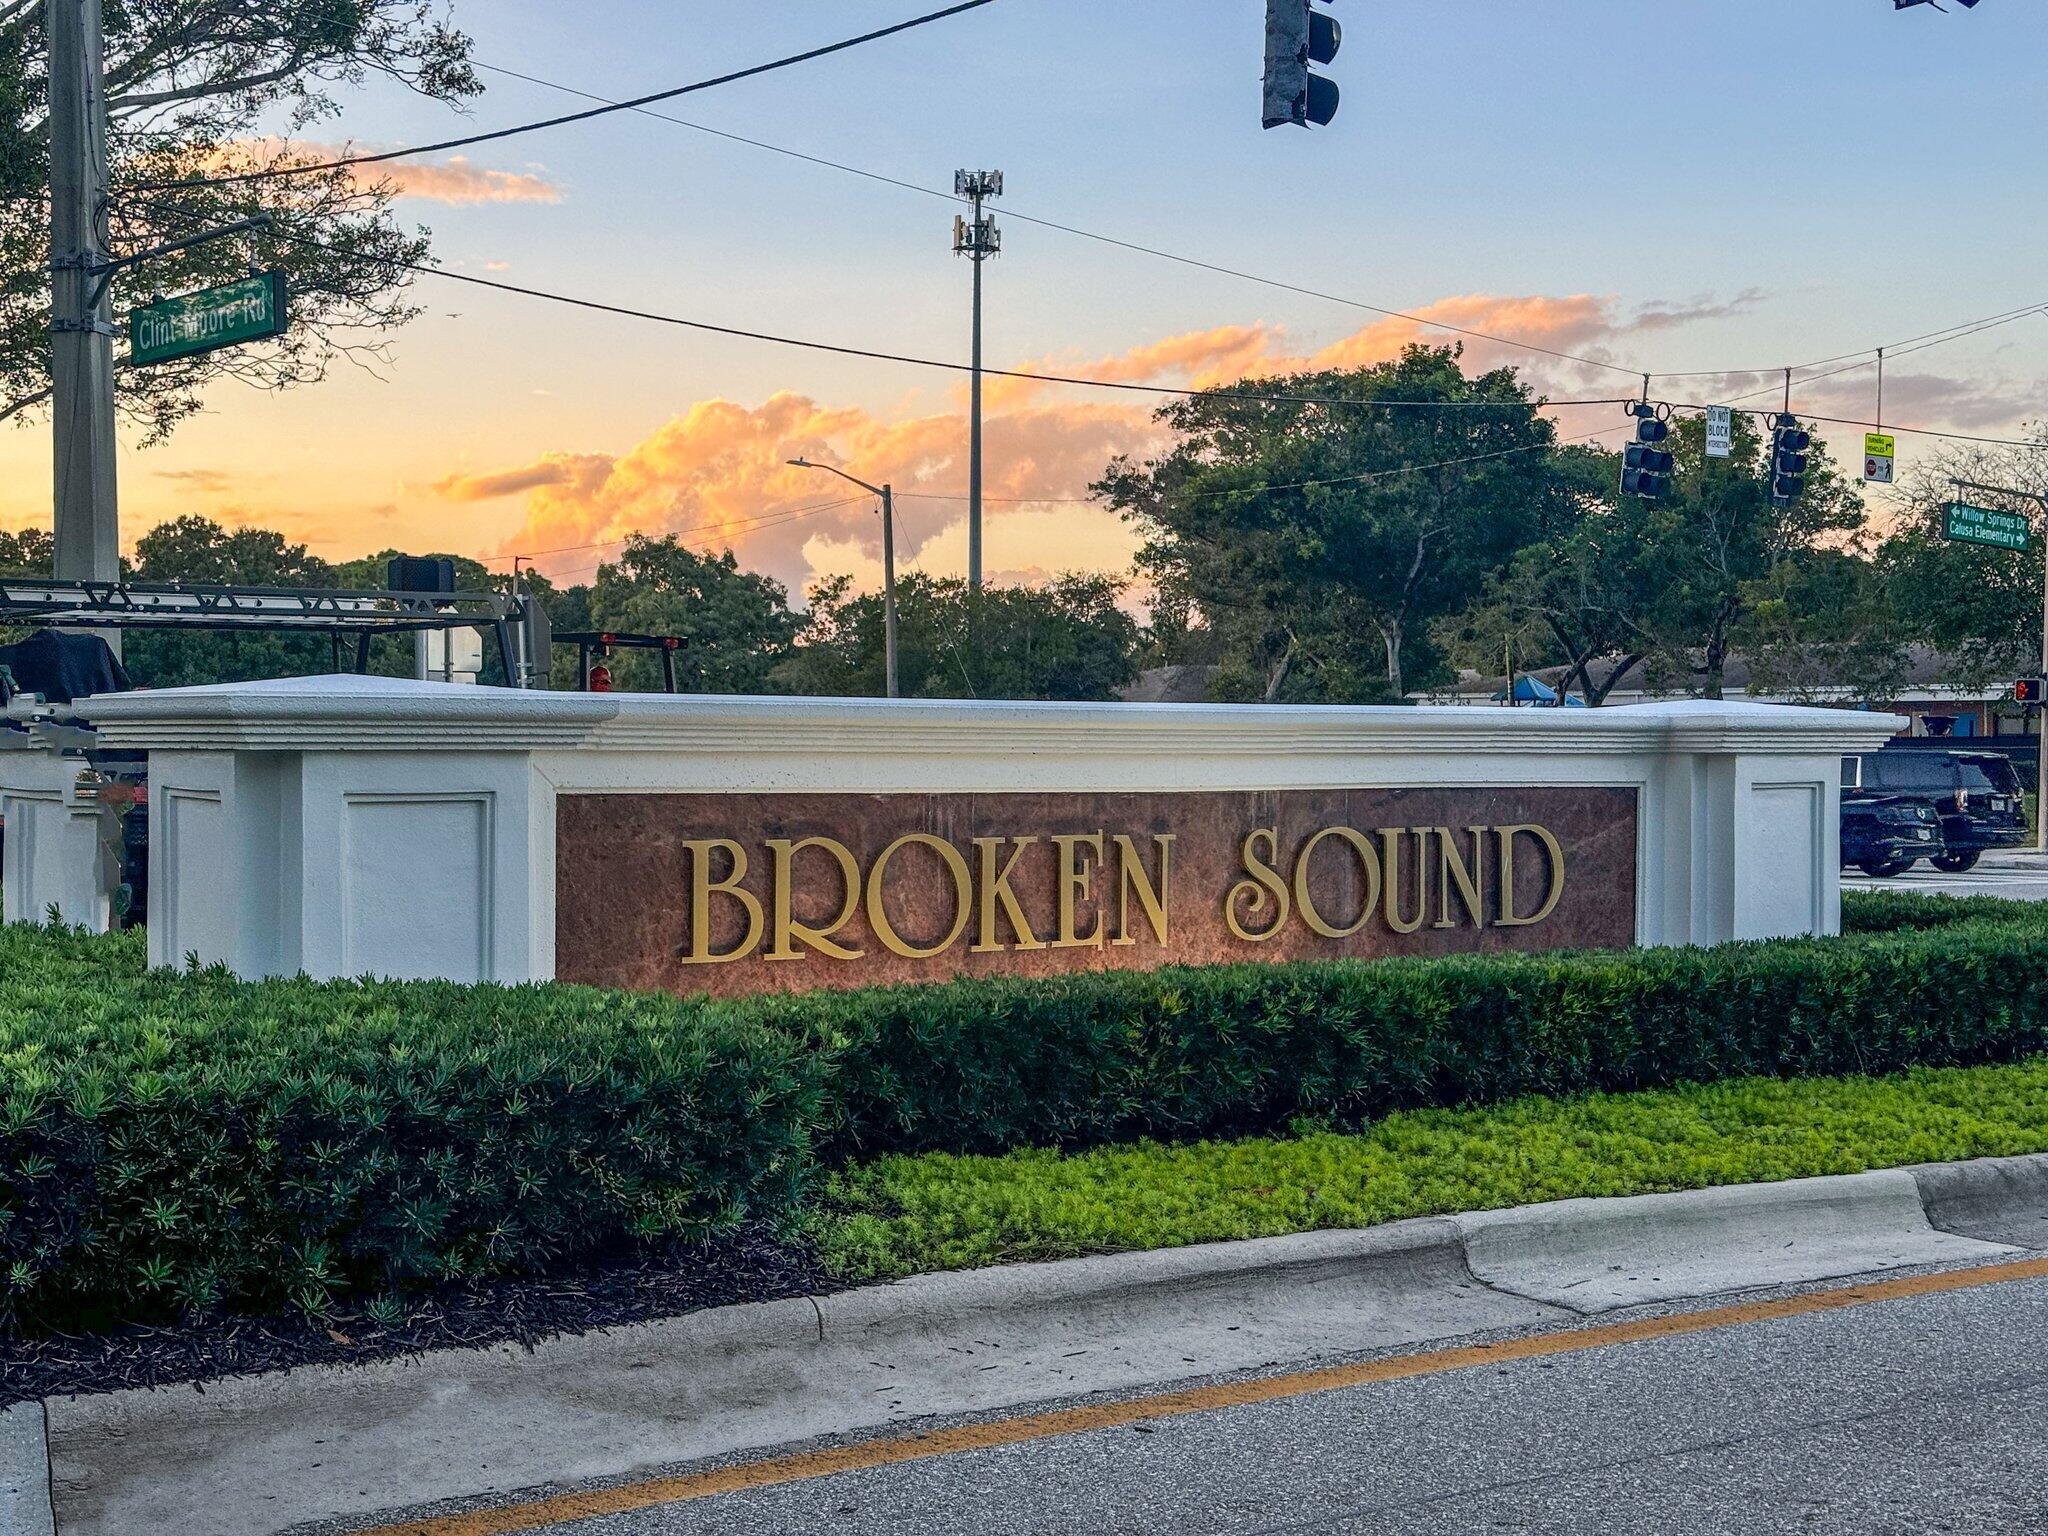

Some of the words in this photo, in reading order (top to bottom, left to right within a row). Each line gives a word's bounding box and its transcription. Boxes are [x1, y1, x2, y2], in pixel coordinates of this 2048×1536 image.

[139, 315, 177, 350] Clint
[244, 290, 266, 324] Rd
[1708, 410, 1717, 422] DO
[1717, 410, 1729, 423] NOT
[1708, 424, 1729, 437] BLOCK
[1961, 506, 1986, 523] Willow
[1987, 511, 2015, 532] Springs
[2016, 516, 2027, 531] Dr
[1949, 520, 1973, 537] Calusa
[1974, 524, 2015, 547] Elementary
[682, 829, 1177, 964] BROKEN
[1225, 824, 1565, 941] SOUND
